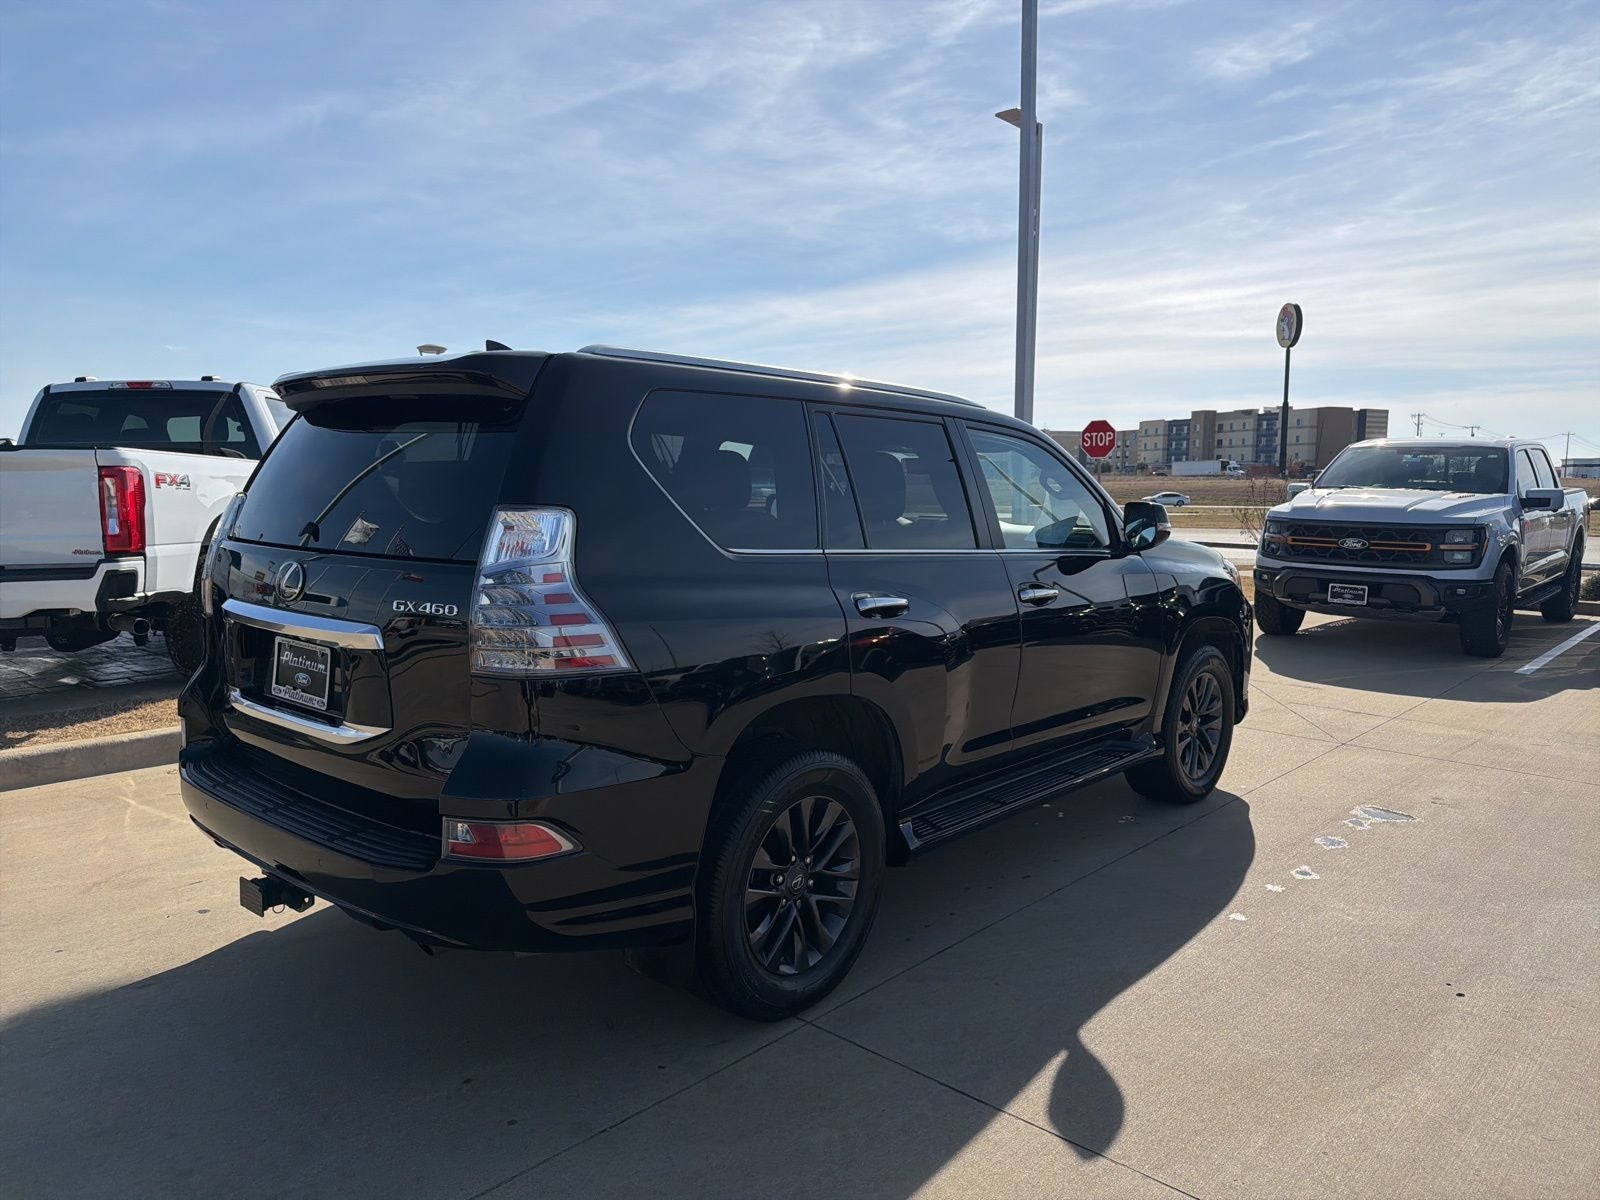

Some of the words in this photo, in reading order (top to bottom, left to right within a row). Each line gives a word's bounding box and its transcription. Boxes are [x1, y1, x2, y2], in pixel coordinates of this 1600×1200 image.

[1083, 431, 1114, 447] STOP
[154, 472, 191, 488] FX4
[280, 651, 327, 674] Platinum
